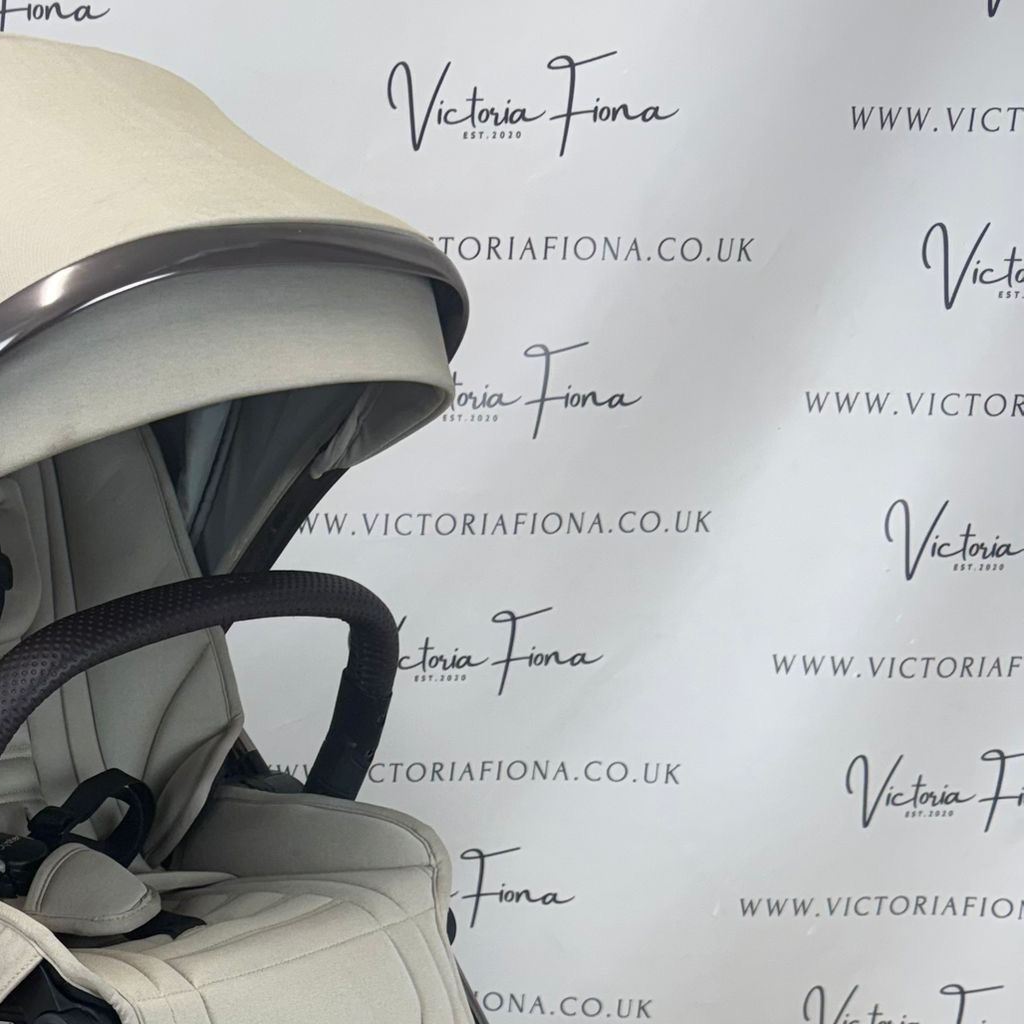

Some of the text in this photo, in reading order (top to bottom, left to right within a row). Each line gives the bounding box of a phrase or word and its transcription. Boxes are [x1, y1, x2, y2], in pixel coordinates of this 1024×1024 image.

[387, 51, 679, 157] Victoria Fiona
[463, 131, 522, 140] EST.2020
[442, 414, 498, 422] EST.2020
[524, 341, 643, 439] Fiona
[884, 499, 1024, 581] Victoria
[492, 606, 604, 697] Fiona
[846, 755, 977, 828] Victoria
[460, 847, 575, 928] Fiona
